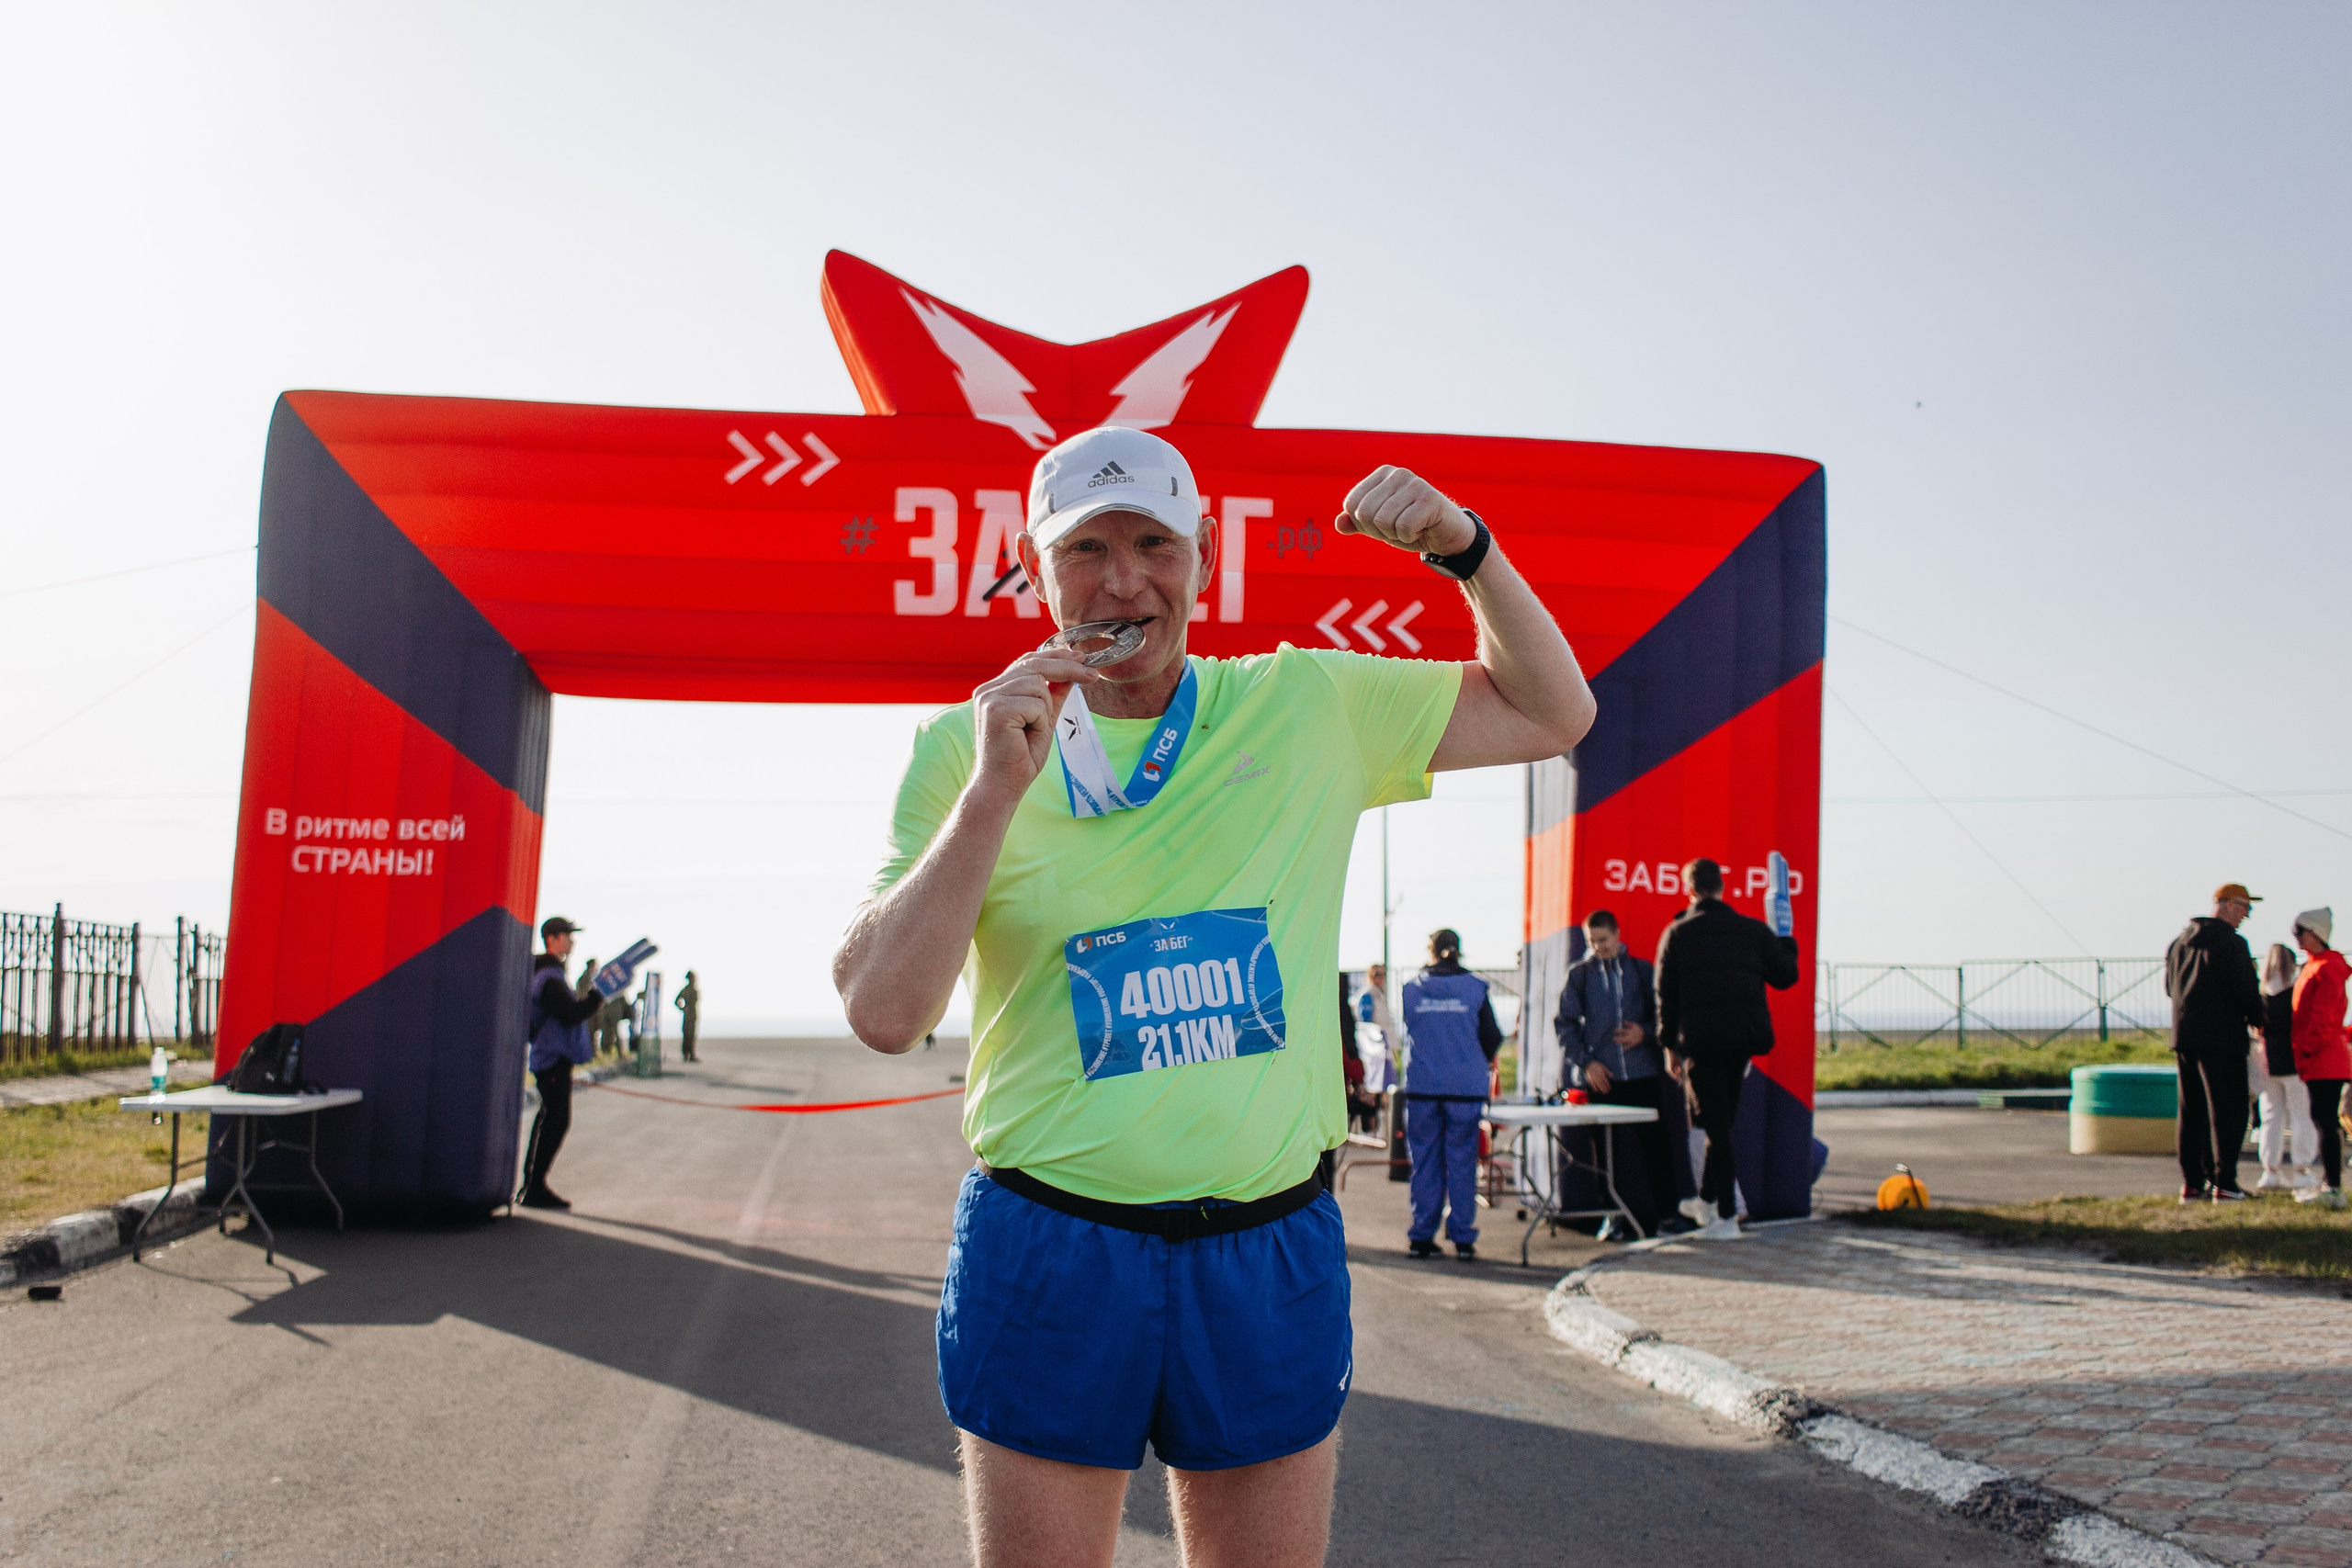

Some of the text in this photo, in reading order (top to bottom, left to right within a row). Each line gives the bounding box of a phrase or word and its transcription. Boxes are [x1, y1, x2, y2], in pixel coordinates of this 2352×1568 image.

[1088, 475, 1135, 488] adidas
[1152, 728, 1178, 761] ПСБ
[1224, 765, 1271, 787] DEMIX
[265, 807, 466, 840] В ритме всей
[291, 844, 435, 875] СТРАНЫ!
[1095, 931, 1126, 947] ПСБ
[1120, 957, 1245, 1019] 40001
